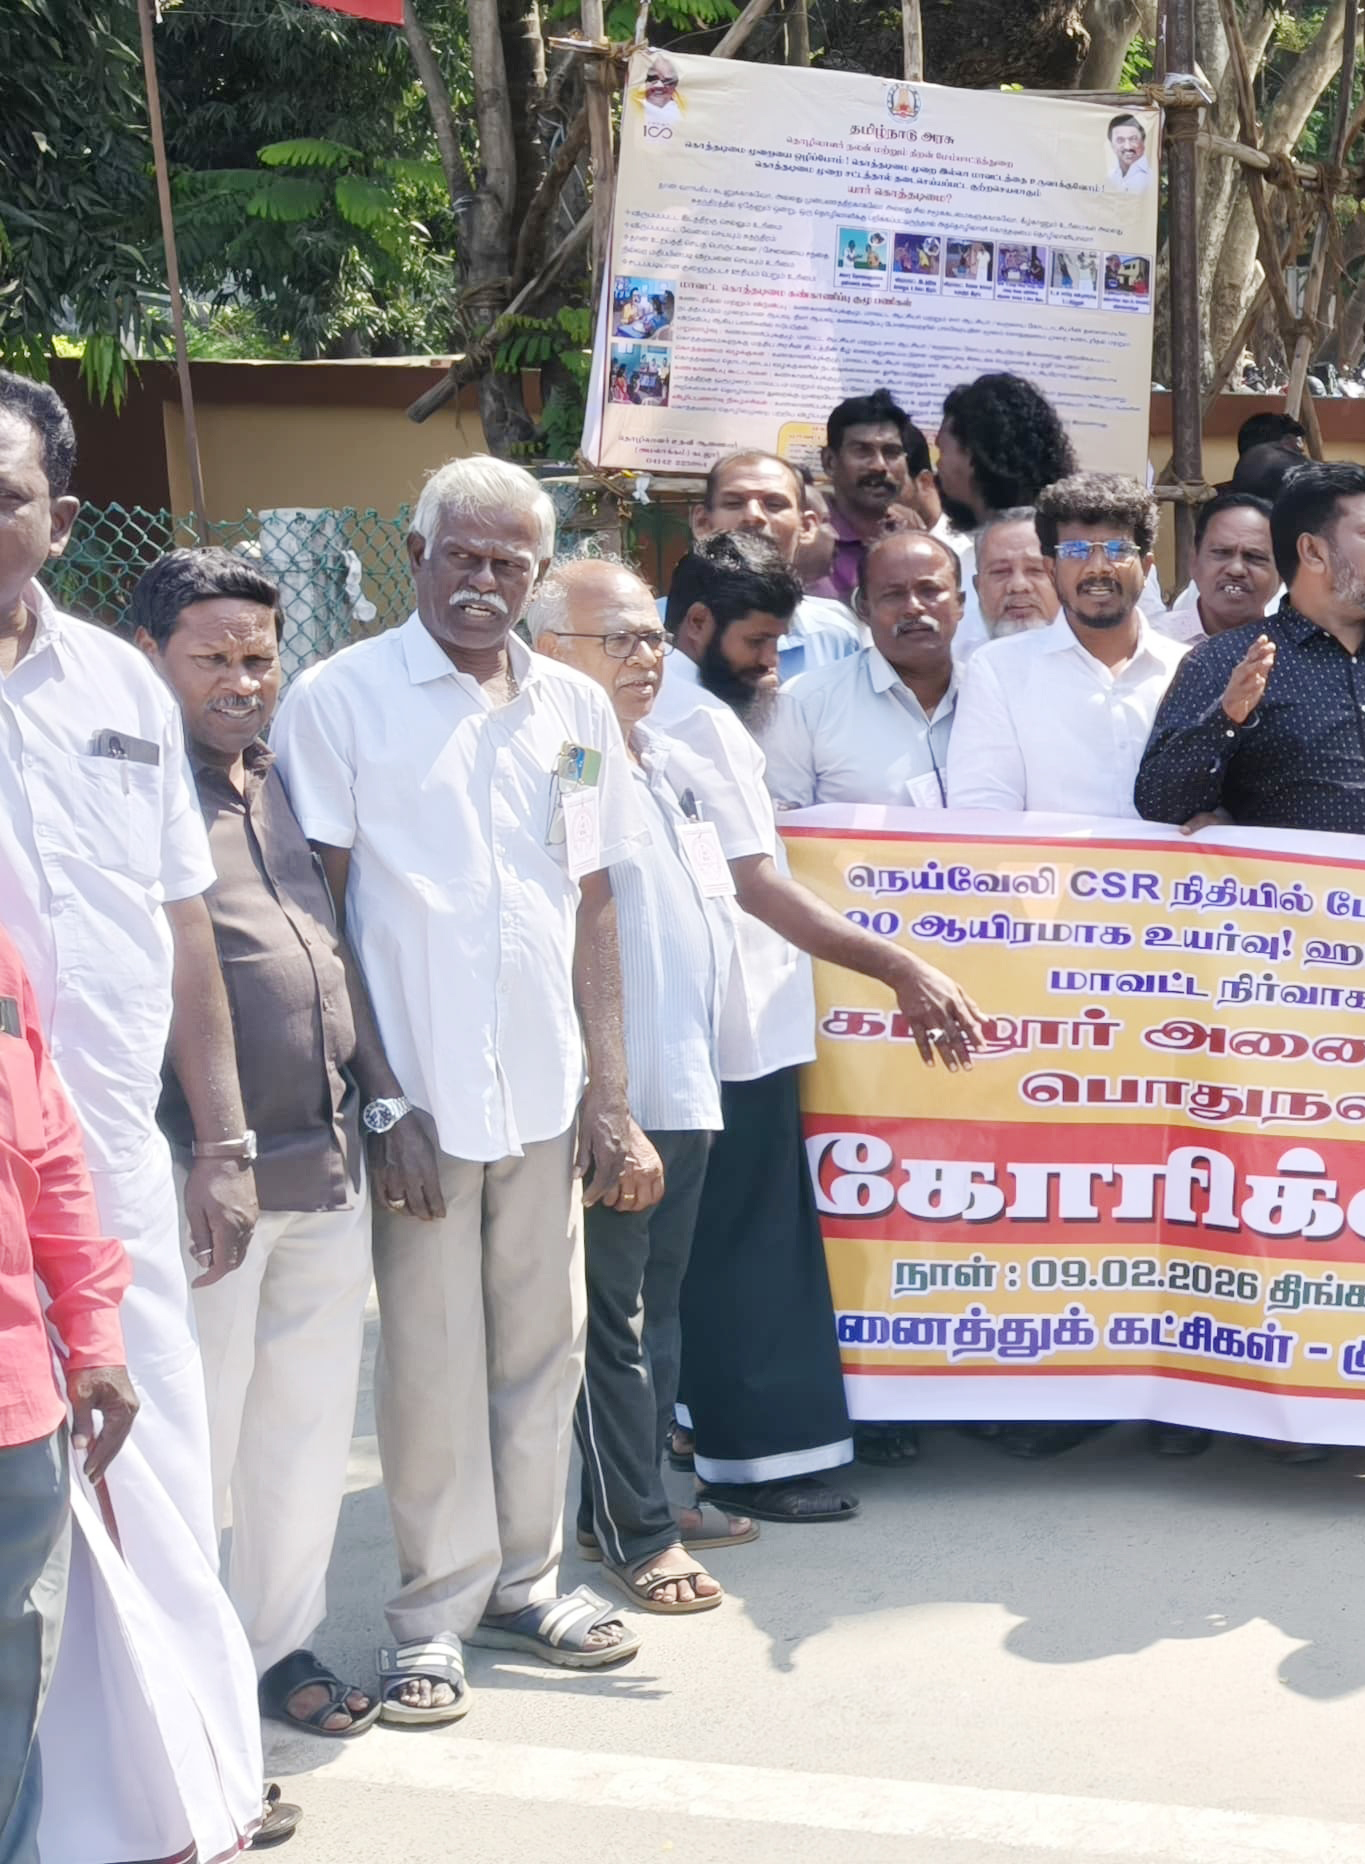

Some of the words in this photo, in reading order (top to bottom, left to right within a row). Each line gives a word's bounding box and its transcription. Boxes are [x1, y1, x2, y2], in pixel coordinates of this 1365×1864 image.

[849, 124, 918, 143] தமிழ்நாடு
[920, 131, 955, 145] அரசு
[849, 861, 1057, 896] நெய்வேலி
[1070, 870, 1160, 900] CSR
[1169, 874, 1313, 913] நிதியில்
[911, 912, 1133, 946] ஆயிரமாக
[1145, 922, 1292, 960] உயர்வு!
[1050, 970, 1209, 997] மாவட்ட
[895, 1256, 996, 1293] நாள்
[1031, 1259, 1258, 1300] 09.02.2026
[834, 1307, 1095, 1358] னைத்துக்
[1109, 1314, 1293, 1364] கட்சிகள்
